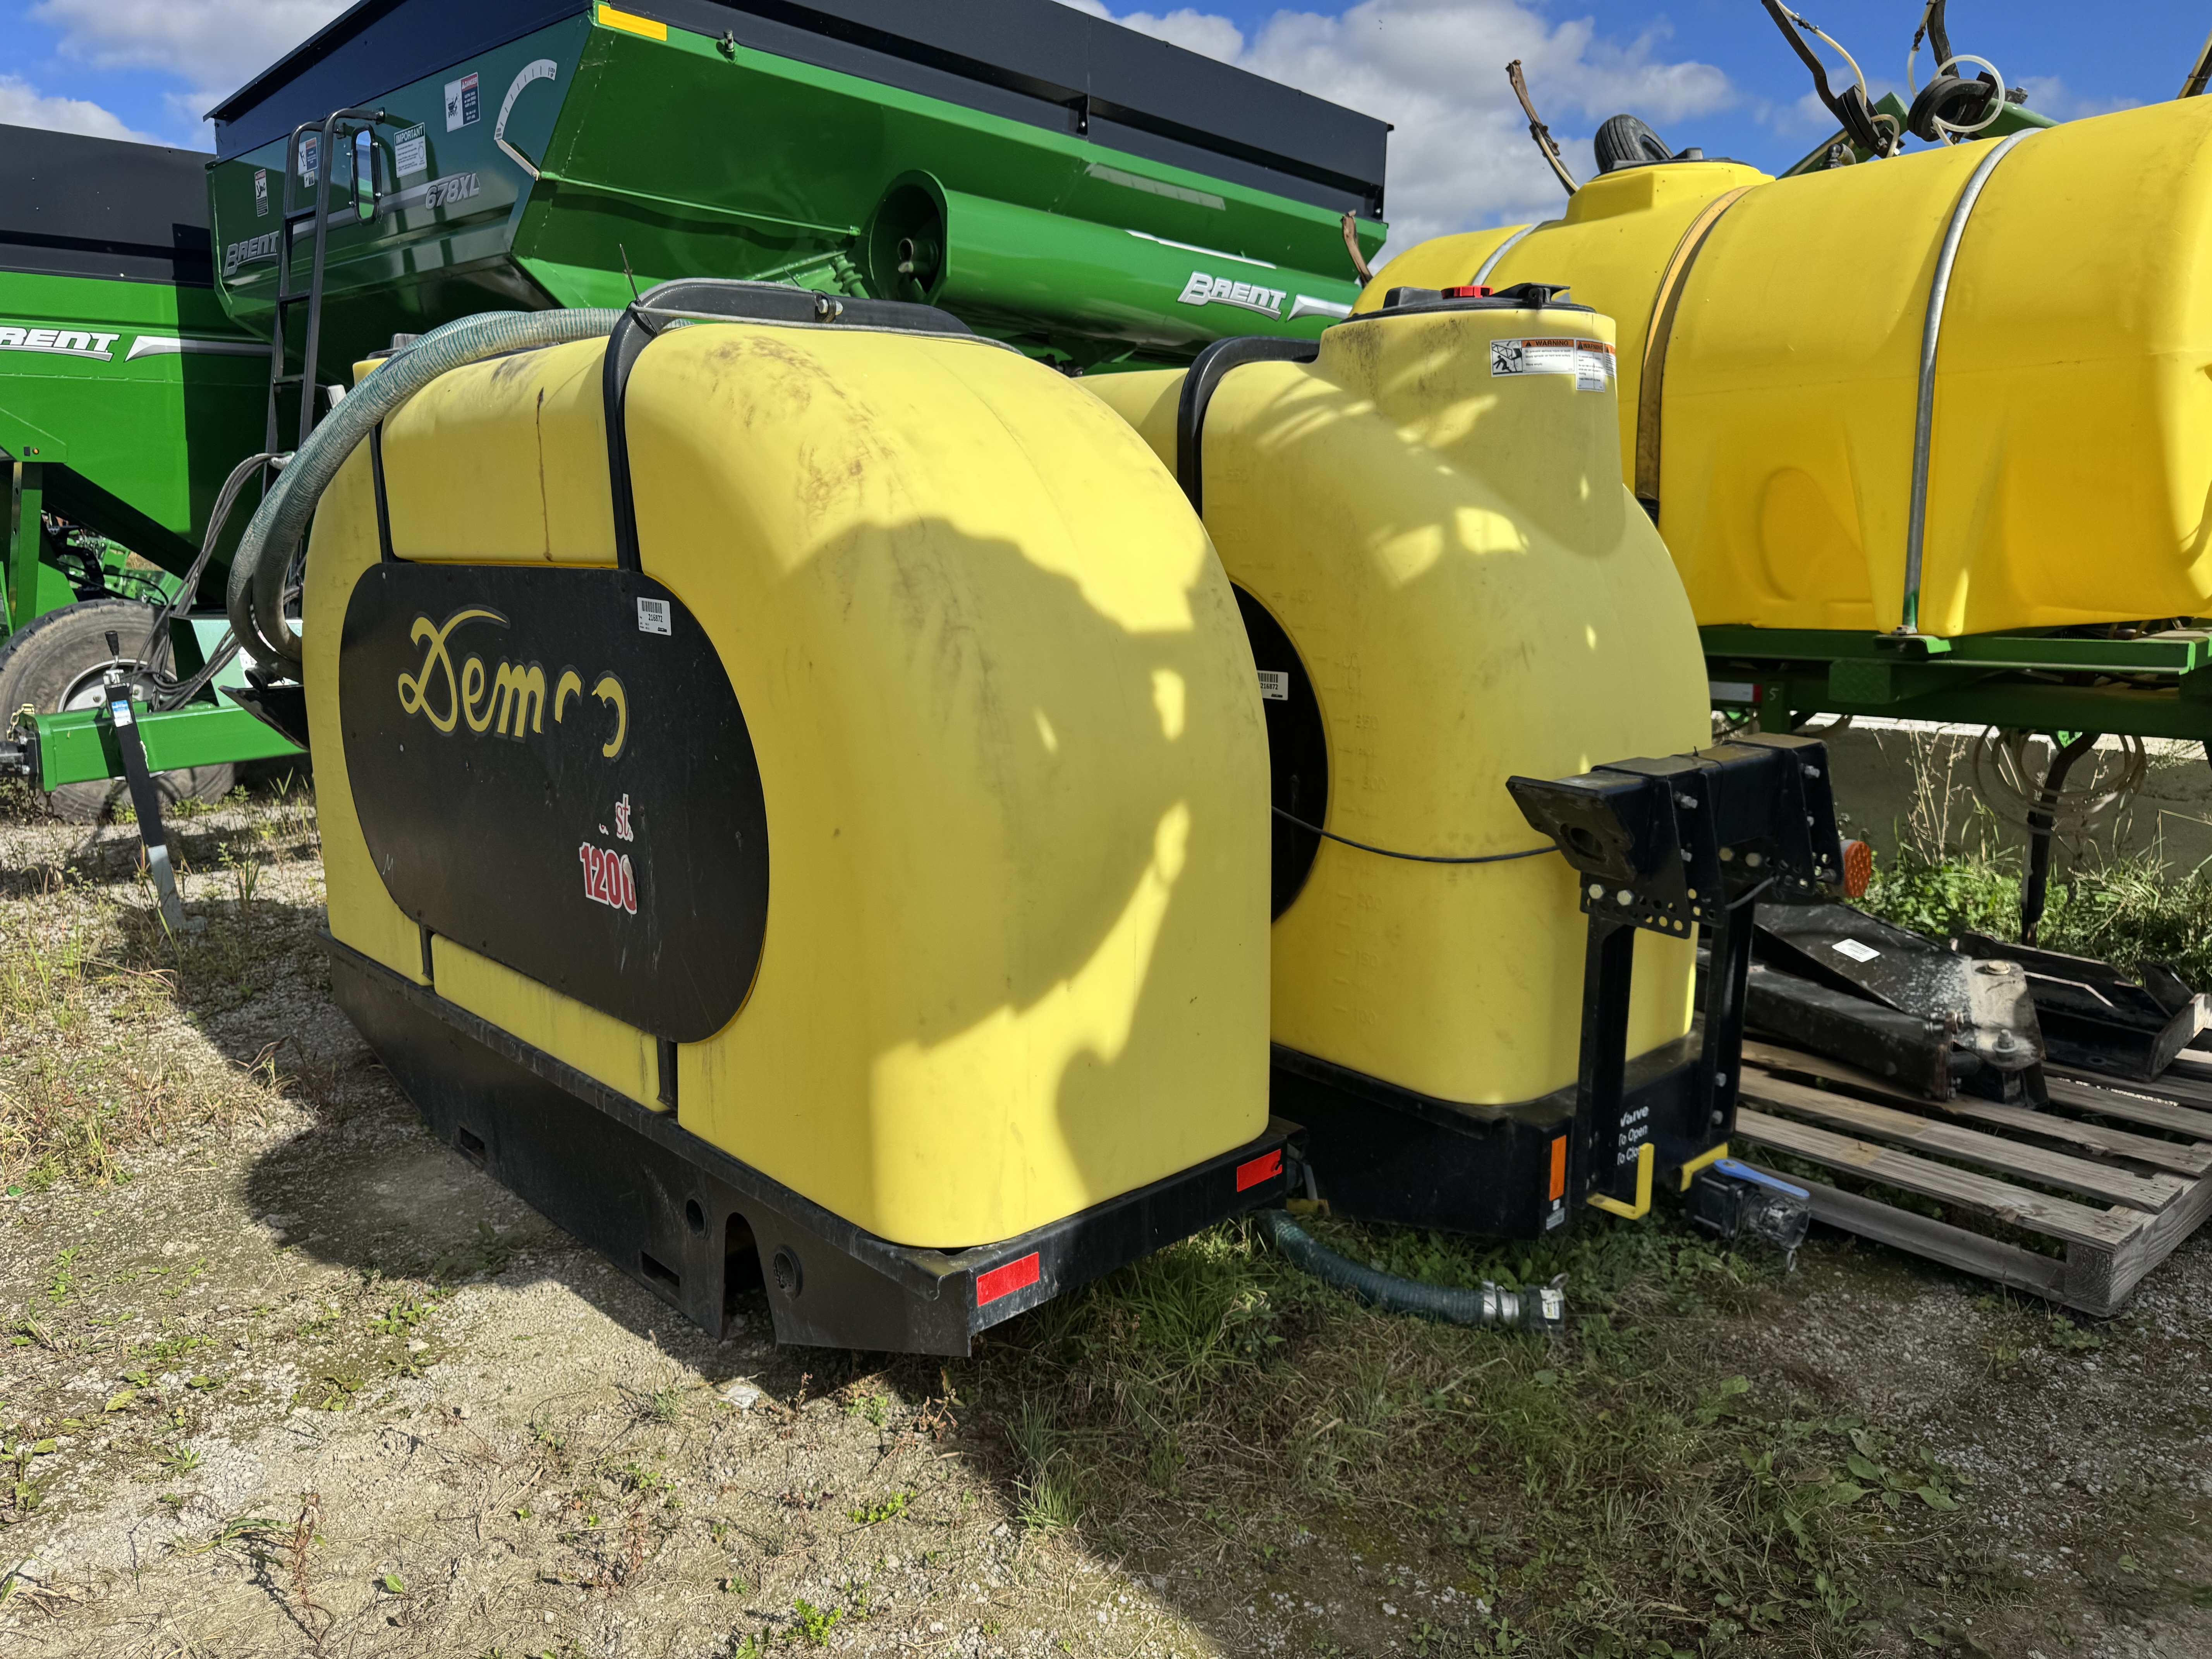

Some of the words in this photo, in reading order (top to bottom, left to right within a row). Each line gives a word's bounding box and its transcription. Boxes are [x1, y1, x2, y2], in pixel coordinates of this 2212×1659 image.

[396, 125, 423, 144] IMPORTANT
[425, 173, 479, 210] 678XL
[223, 230, 280, 277] BRENT
[1177, 271, 1287, 311] BRENT
[648, 613, 663, 622] 216872
[579, 842, 637, 915] 1200
[1620, 1106, 1649, 1127] Valve
[1628, 1124, 1649, 1143] Open
[1626, 1145, 1640, 1162] Clo
